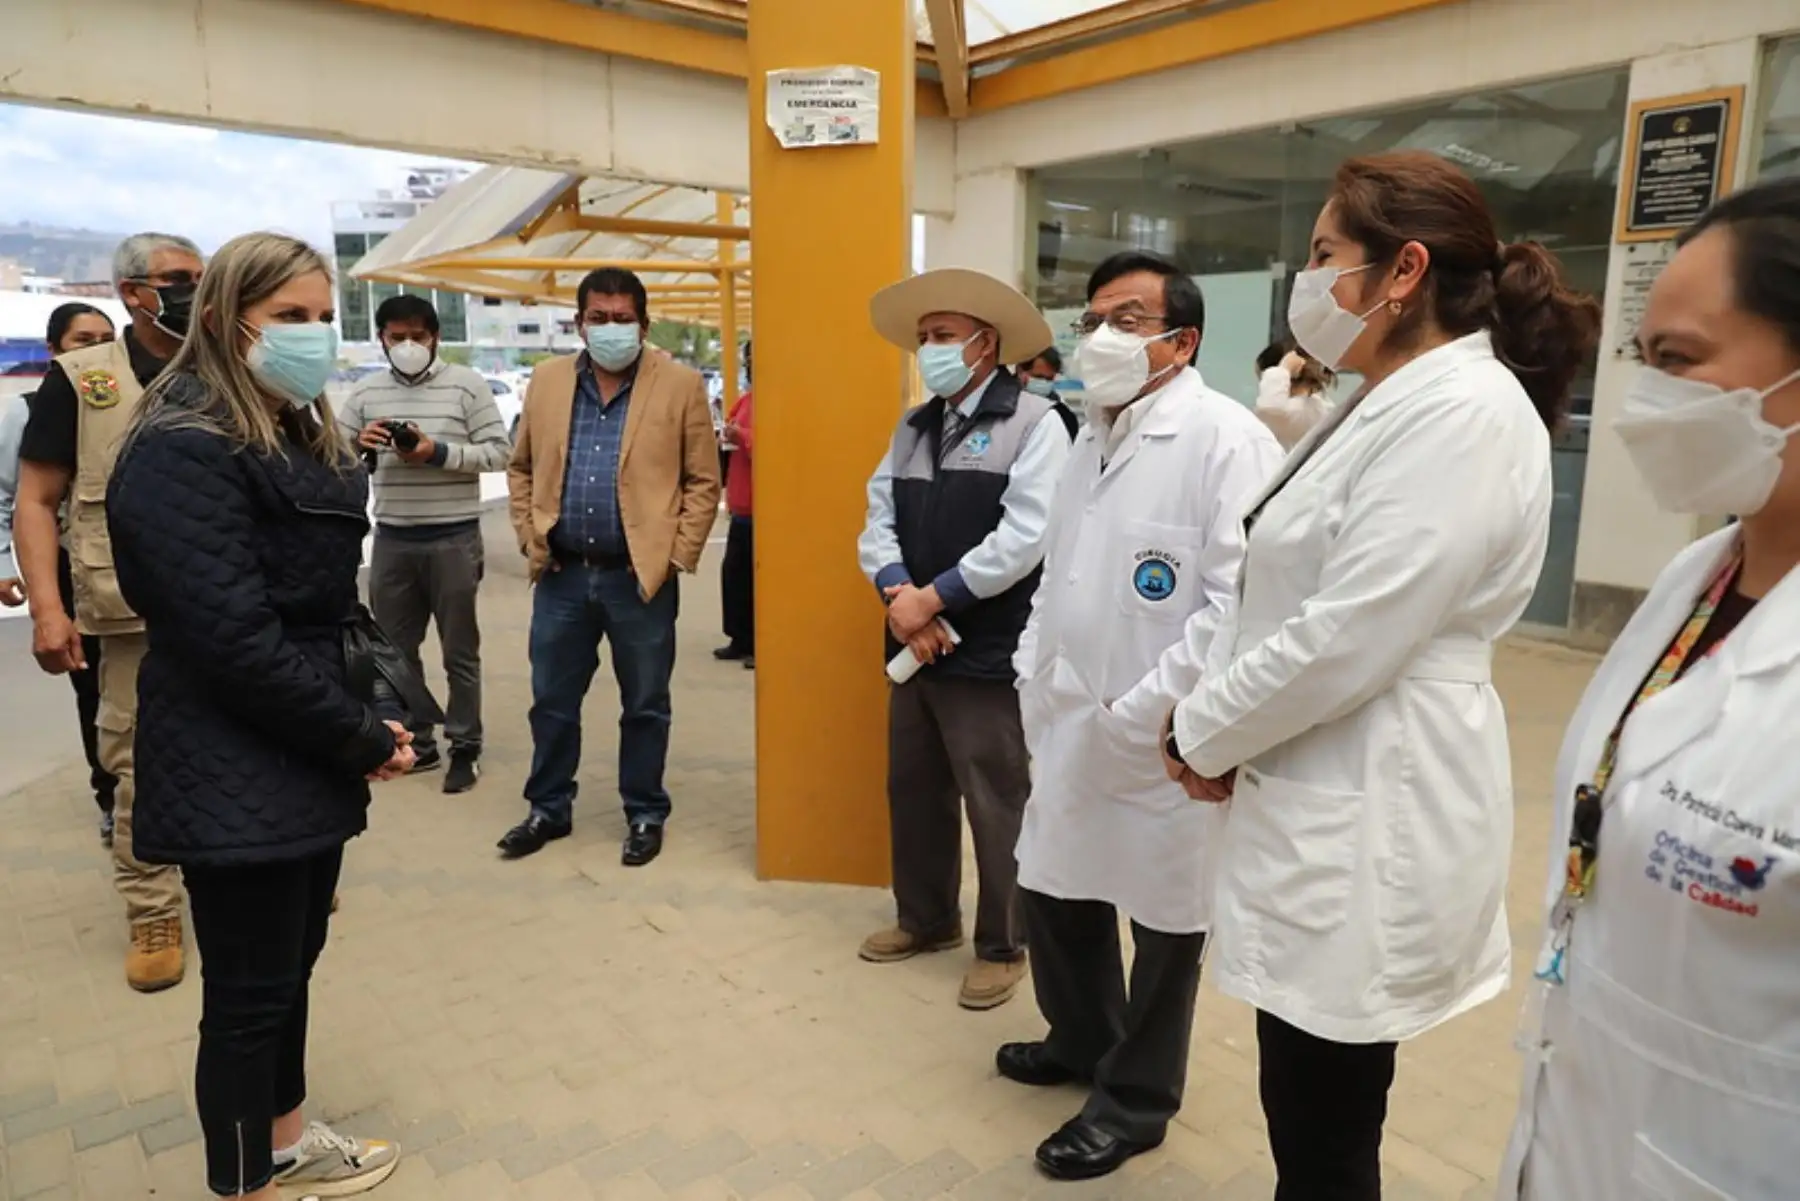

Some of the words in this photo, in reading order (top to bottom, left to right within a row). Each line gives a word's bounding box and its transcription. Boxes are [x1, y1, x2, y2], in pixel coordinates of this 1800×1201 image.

[786, 99, 858, 109] EMERGENCIA
[1655, 829, 1713, 869] Oficina
[1687, 882, 1759, 917] Calidad
